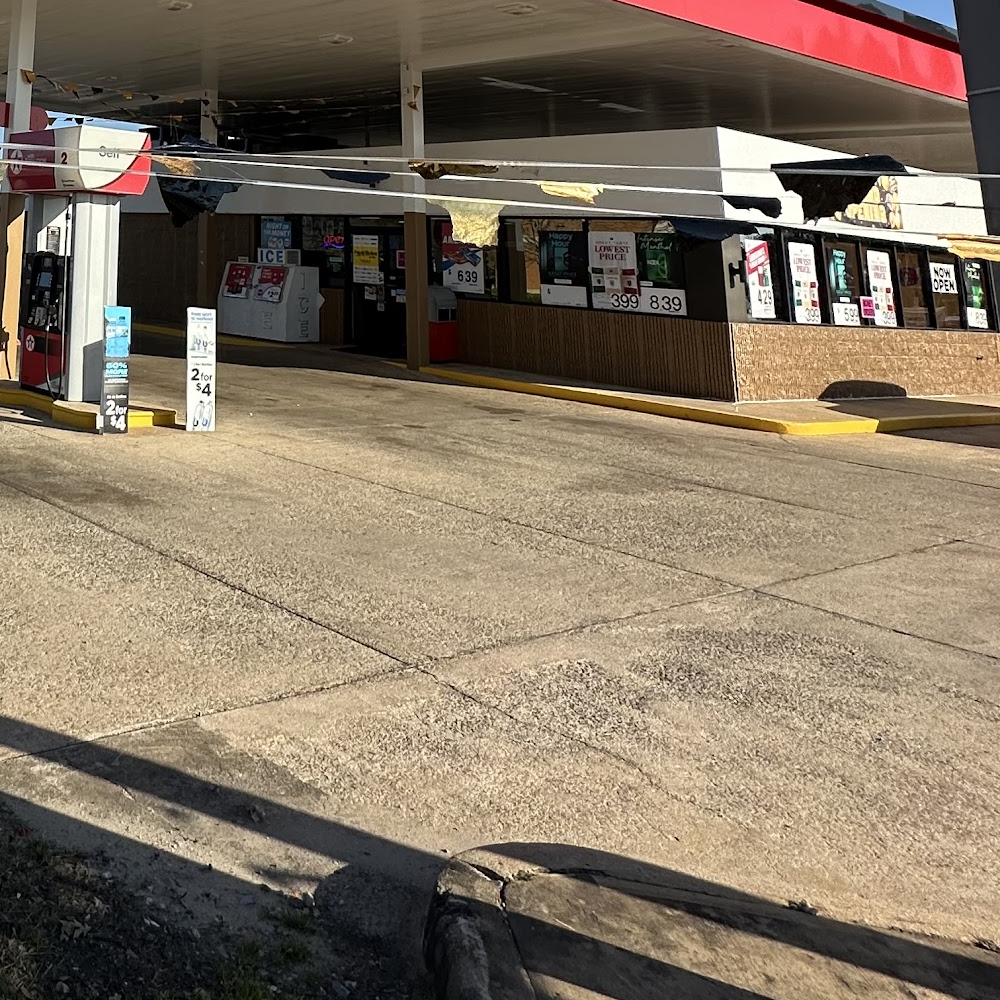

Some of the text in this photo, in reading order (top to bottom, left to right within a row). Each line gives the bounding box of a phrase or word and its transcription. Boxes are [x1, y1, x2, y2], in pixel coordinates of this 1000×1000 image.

[61, 152, 68, 165] 2
[548, 232, 573, 241] Happy
[594, 245, 631, 254] LOWEST
[260, 250, 284, 263] ICE
[599, 253, 627, 261] PRICE
[457, 270, 478, 283] 639
[933, 266, 951, 279] NOW
[933, 278, 955, 292] OPEN
[611, 293, 639, 309] 399
[650, 295, 682, 312] 839
[759, 289, 775, 305] 429
[190, 368, 212, 381] 2 for
[196, 382, 212, 397] $4
[105, 399, 128, 415] 2 for
[110, 415, 126, 431] $4
